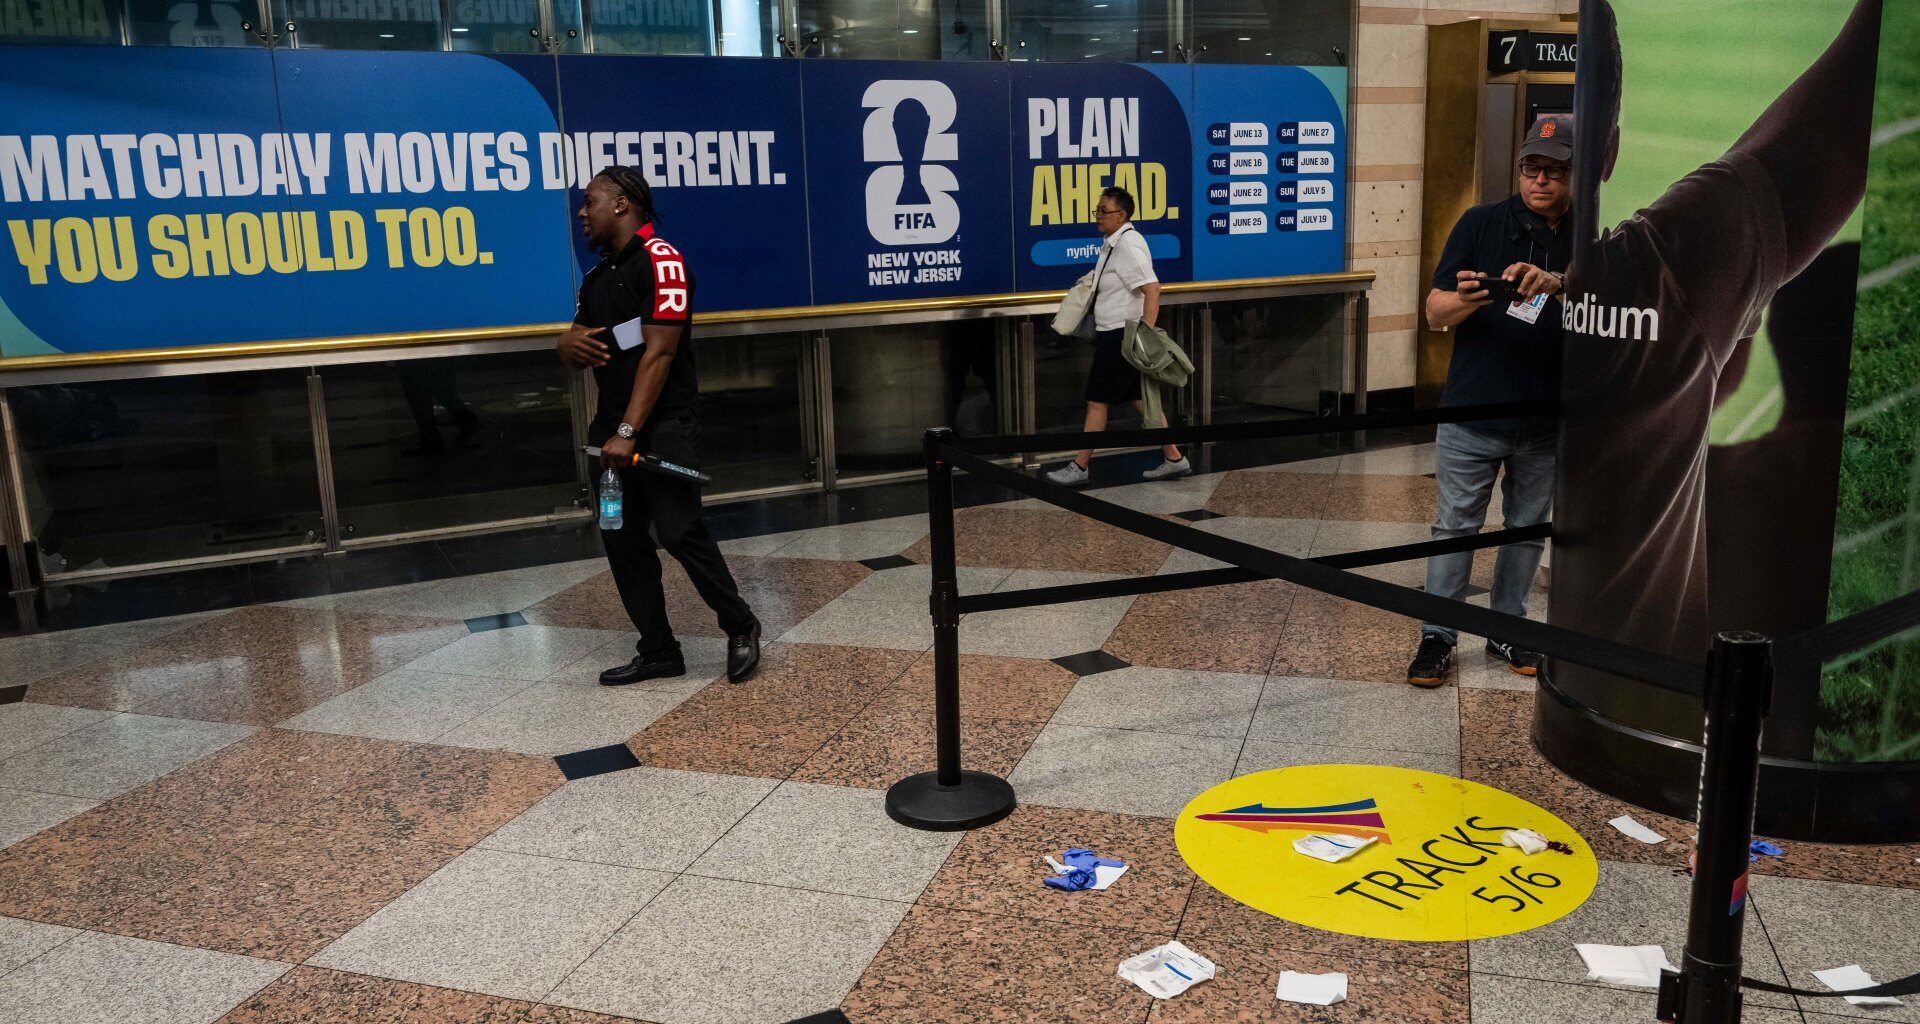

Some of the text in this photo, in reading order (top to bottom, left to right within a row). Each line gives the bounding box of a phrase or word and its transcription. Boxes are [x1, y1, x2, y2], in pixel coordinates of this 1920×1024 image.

[1500, 36, 1517, 65] 7
[1028, 97, 1140, 160] PLAN
[1212, 129, 1262, 138] SAT JUNE 13
[1281, 128, 1330, 137] SAT JUNE 27
[0, 131, 787, 202] MATCHDAY MOVES DIFFERENT.
[1212, 158, 1262, 168] TUE JUNE 16
[1281, 157, 1329, 166] TUE JUNE 30
[1030, 162, 1179, 226] AHEAD.
[1210, 188, 1262, 198] MON JUNE 22
[1280, 187, 1295, 196] SUN
[1303, 187, 1320, 195] JULY
[894, 213, 936, 229] FIFA
[1212, 218, 1262, 228] THU JUNE 25
[1279, 215, 1327, 225] SUN JULY 19
[7, 206, 494, 285] YOU SHOULD TOO.
[868, 250, 961, 268] NEW YORK
[869, 267, 962, 286] NEW JERSEY
[1335, 816, 1520, 911] TRACKS
[1471, 866, 1561, 912] 5/6
